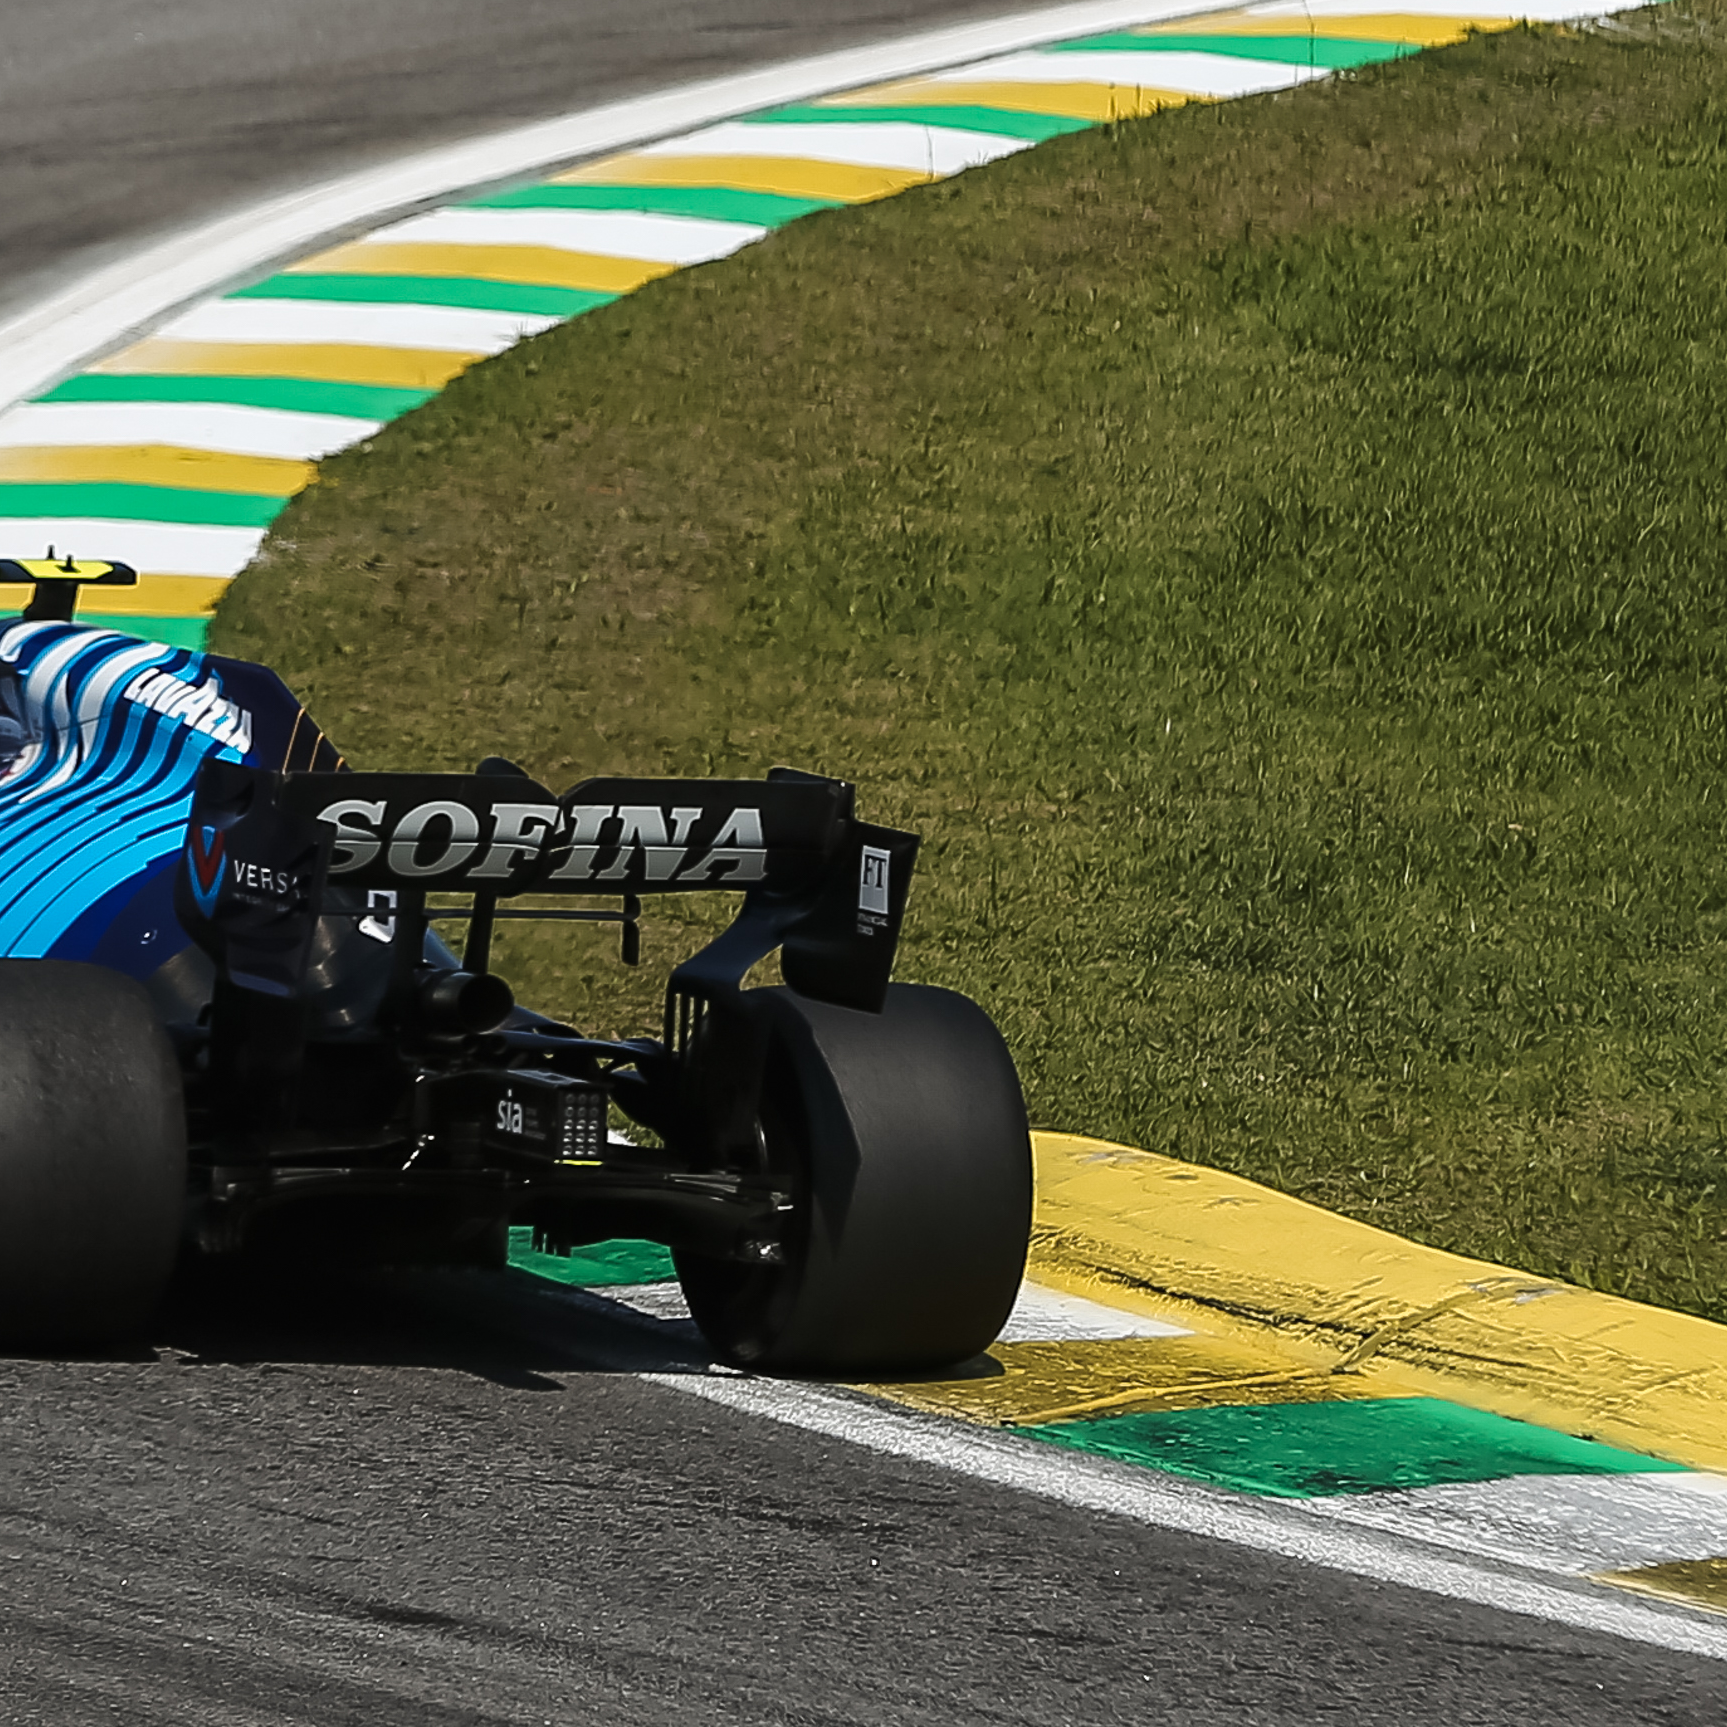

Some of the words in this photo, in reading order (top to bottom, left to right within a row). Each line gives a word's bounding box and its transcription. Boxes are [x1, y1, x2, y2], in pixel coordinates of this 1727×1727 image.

[124, 668, 252, 754] LAVAZZA
[316, 799, 769, 882] SOFINA
[862, 854, 888, 889] FT
[496, 1087, 523, 1134] sia
